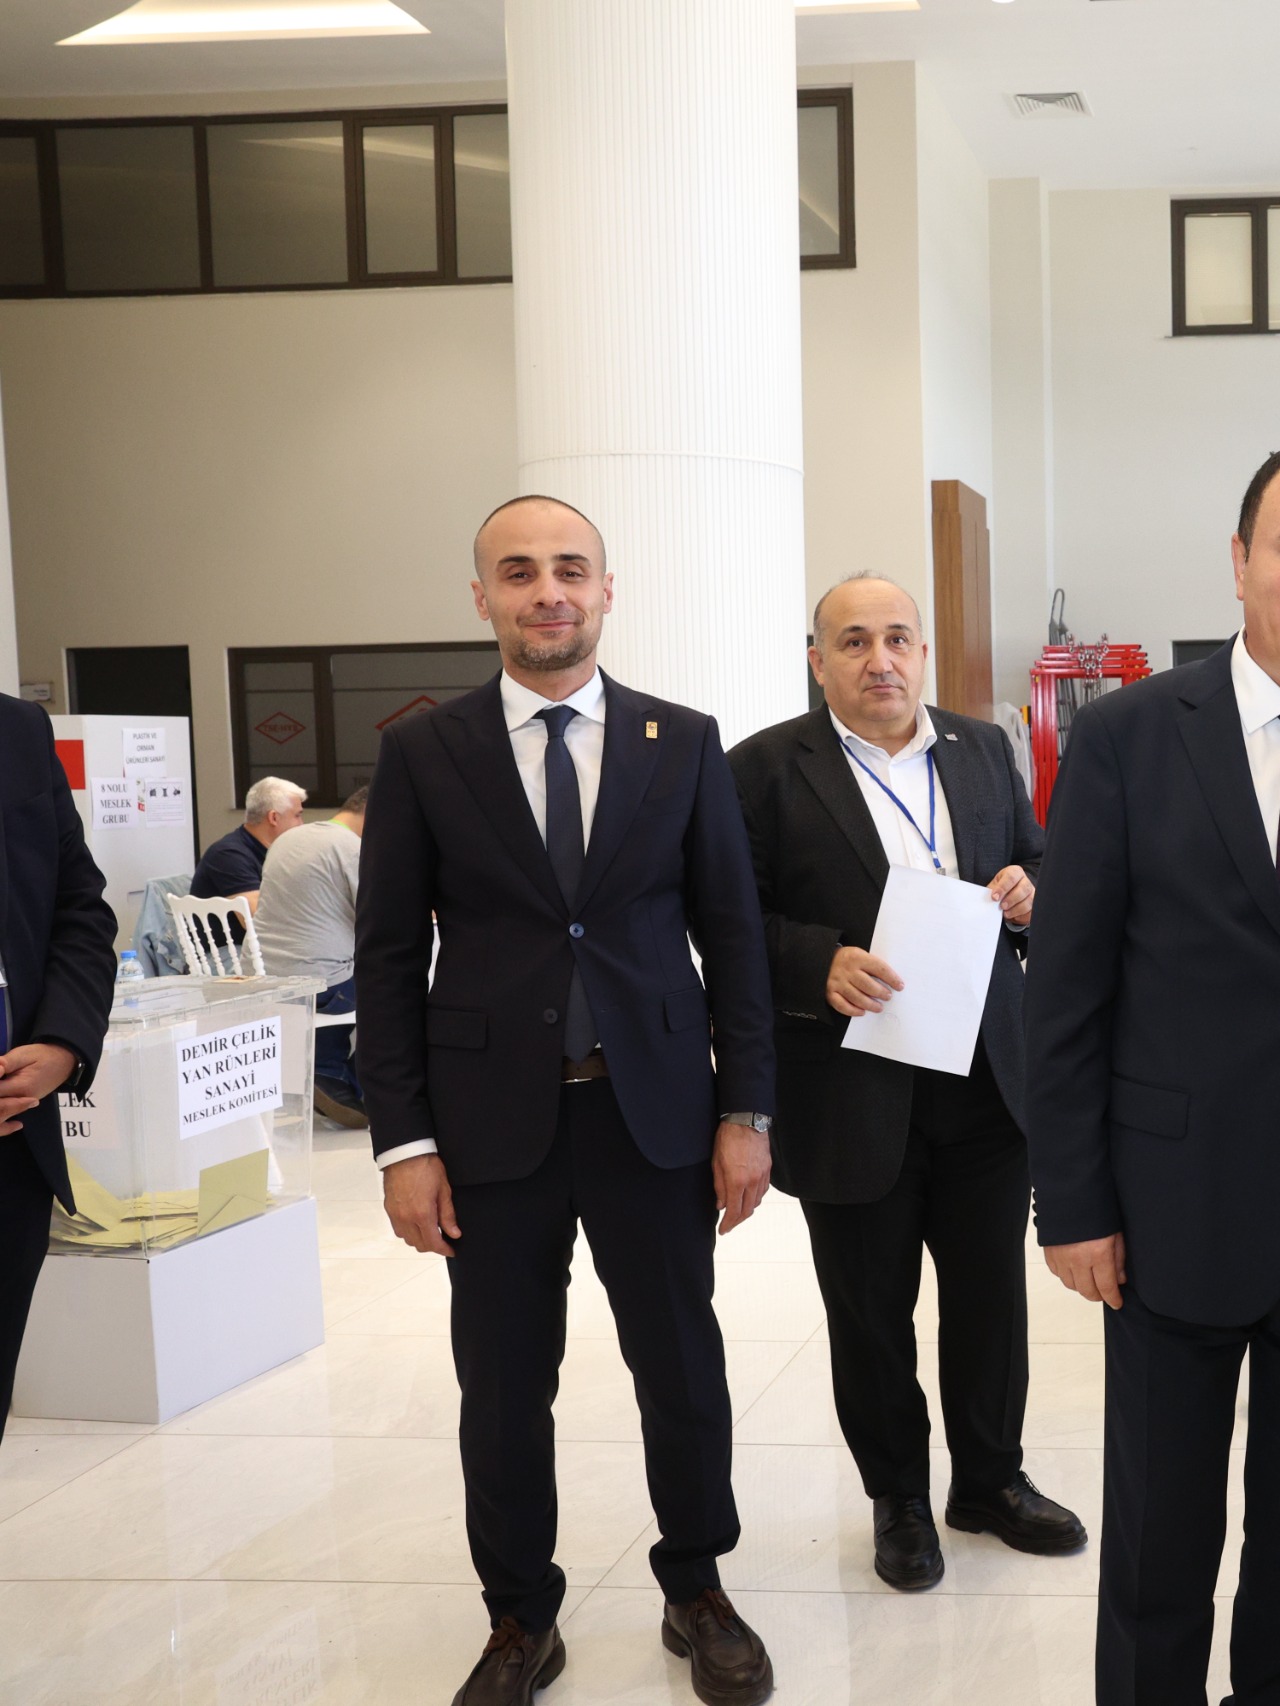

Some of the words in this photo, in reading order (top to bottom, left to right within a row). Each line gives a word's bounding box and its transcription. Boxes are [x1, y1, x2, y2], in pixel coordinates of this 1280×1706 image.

[100, 783, 106, 793] 8
[107, 783, 128, 793] NOLU
[100, 799, 132, 809] MESLEK
[102, 814, 129, 824] GRUBU
[181, 1036, 228, 1063] DEMİR
[231, 1024, 276, 1050] ÇELİK
[182, 1063, 212, 1085] YAN
[215, 1043, 277, 1075] RÜNLERİ
[205, 1069, 256, 1101] SANAYİ
[183, 1102, 227, 1126] MESLEK
[228, 1083, 278, 1110] KOMİTESİ
